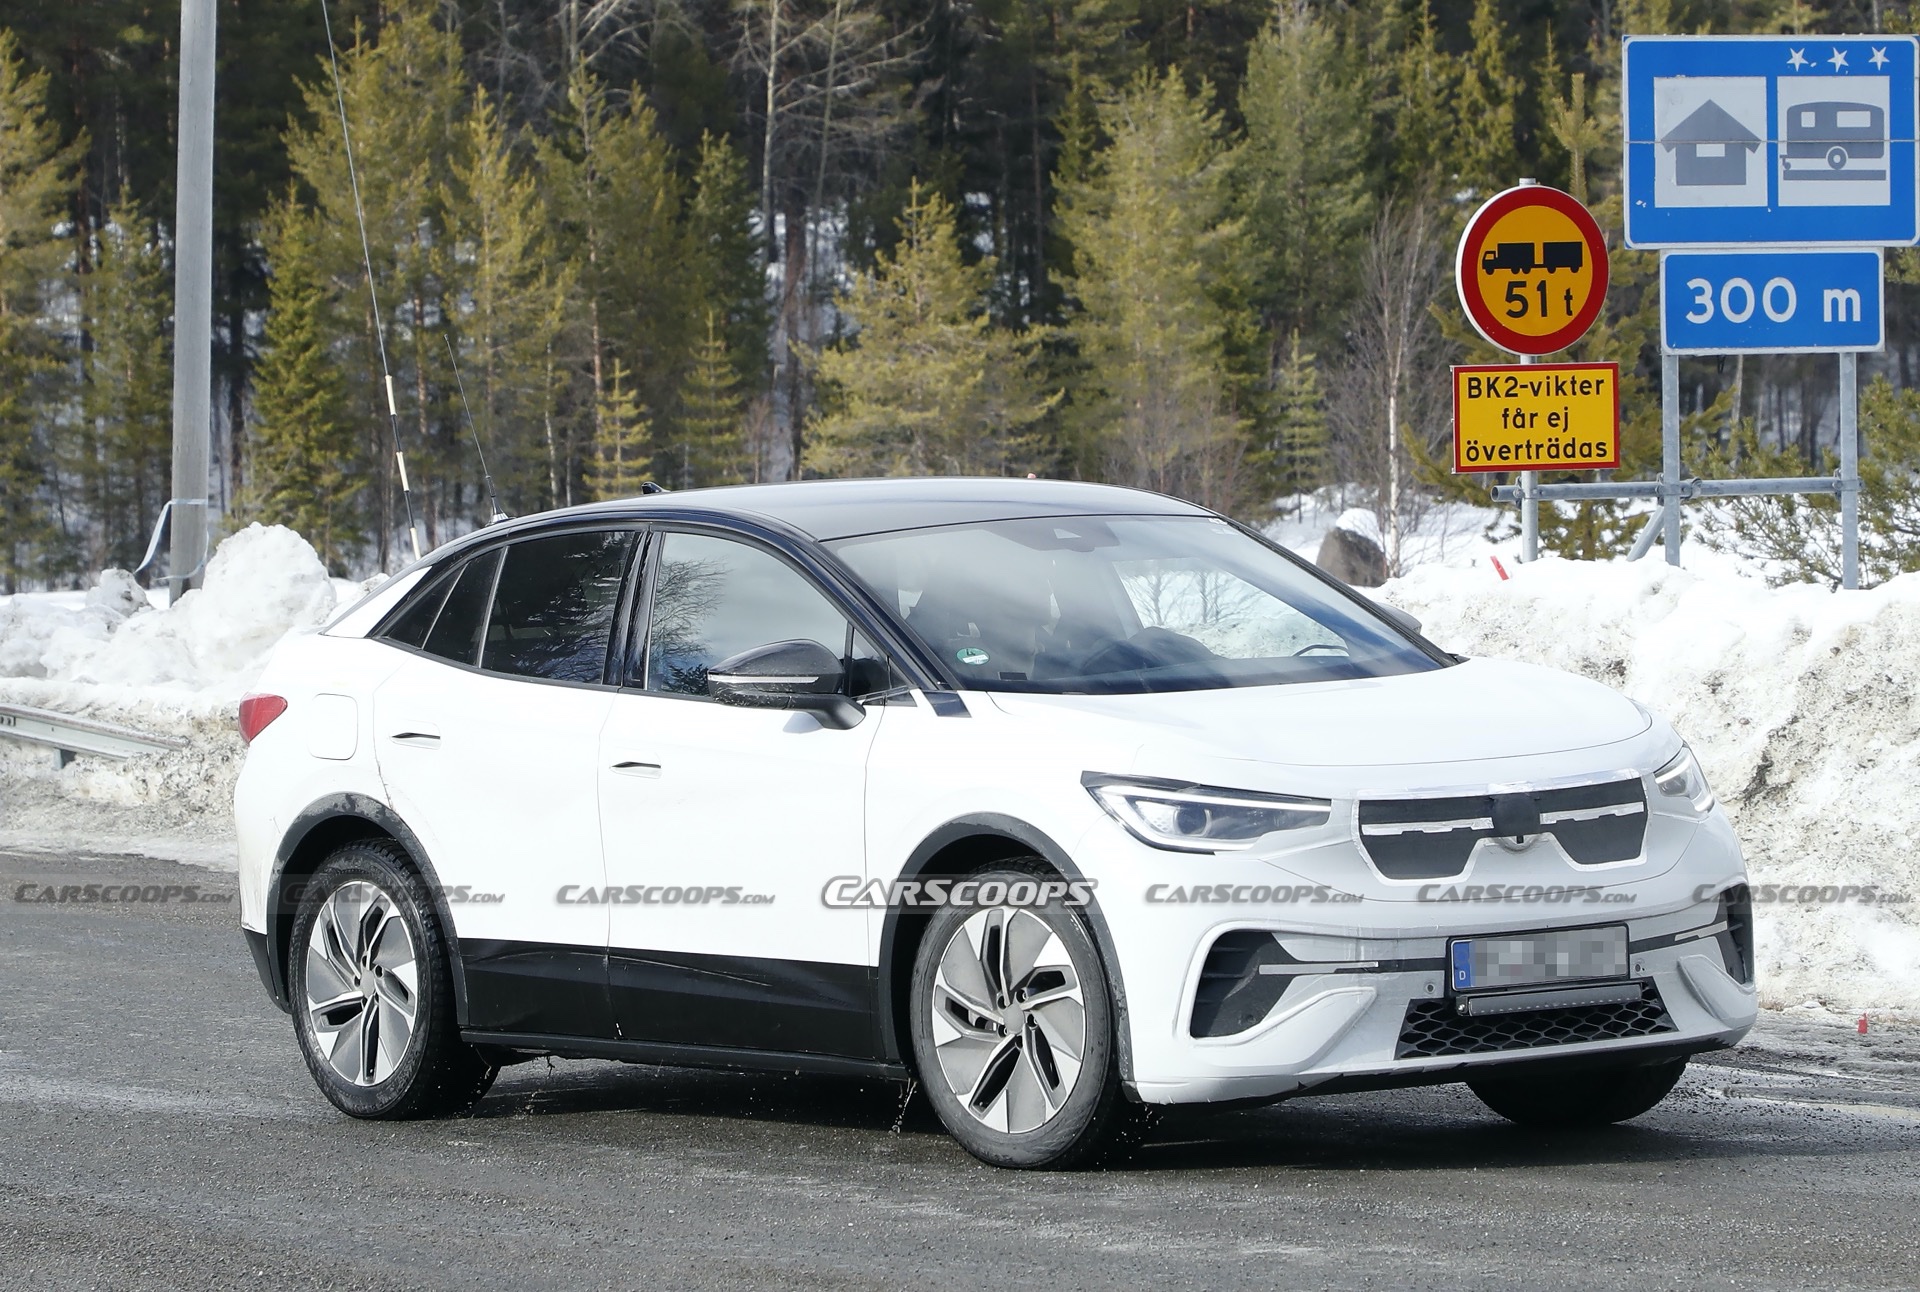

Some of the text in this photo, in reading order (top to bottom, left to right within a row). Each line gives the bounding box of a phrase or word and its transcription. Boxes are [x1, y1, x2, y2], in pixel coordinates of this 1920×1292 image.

[1505, 280, 1573, 318] 51 t
[1685, 277, 1861, 324] 300 m
[1467, 375, 1605, 399] BK2-vikter
[1502, 406, 1569, 433] får ej
[1466, 437, 1608, 462] överträdas
[1459, 970, 1467, 981] D
